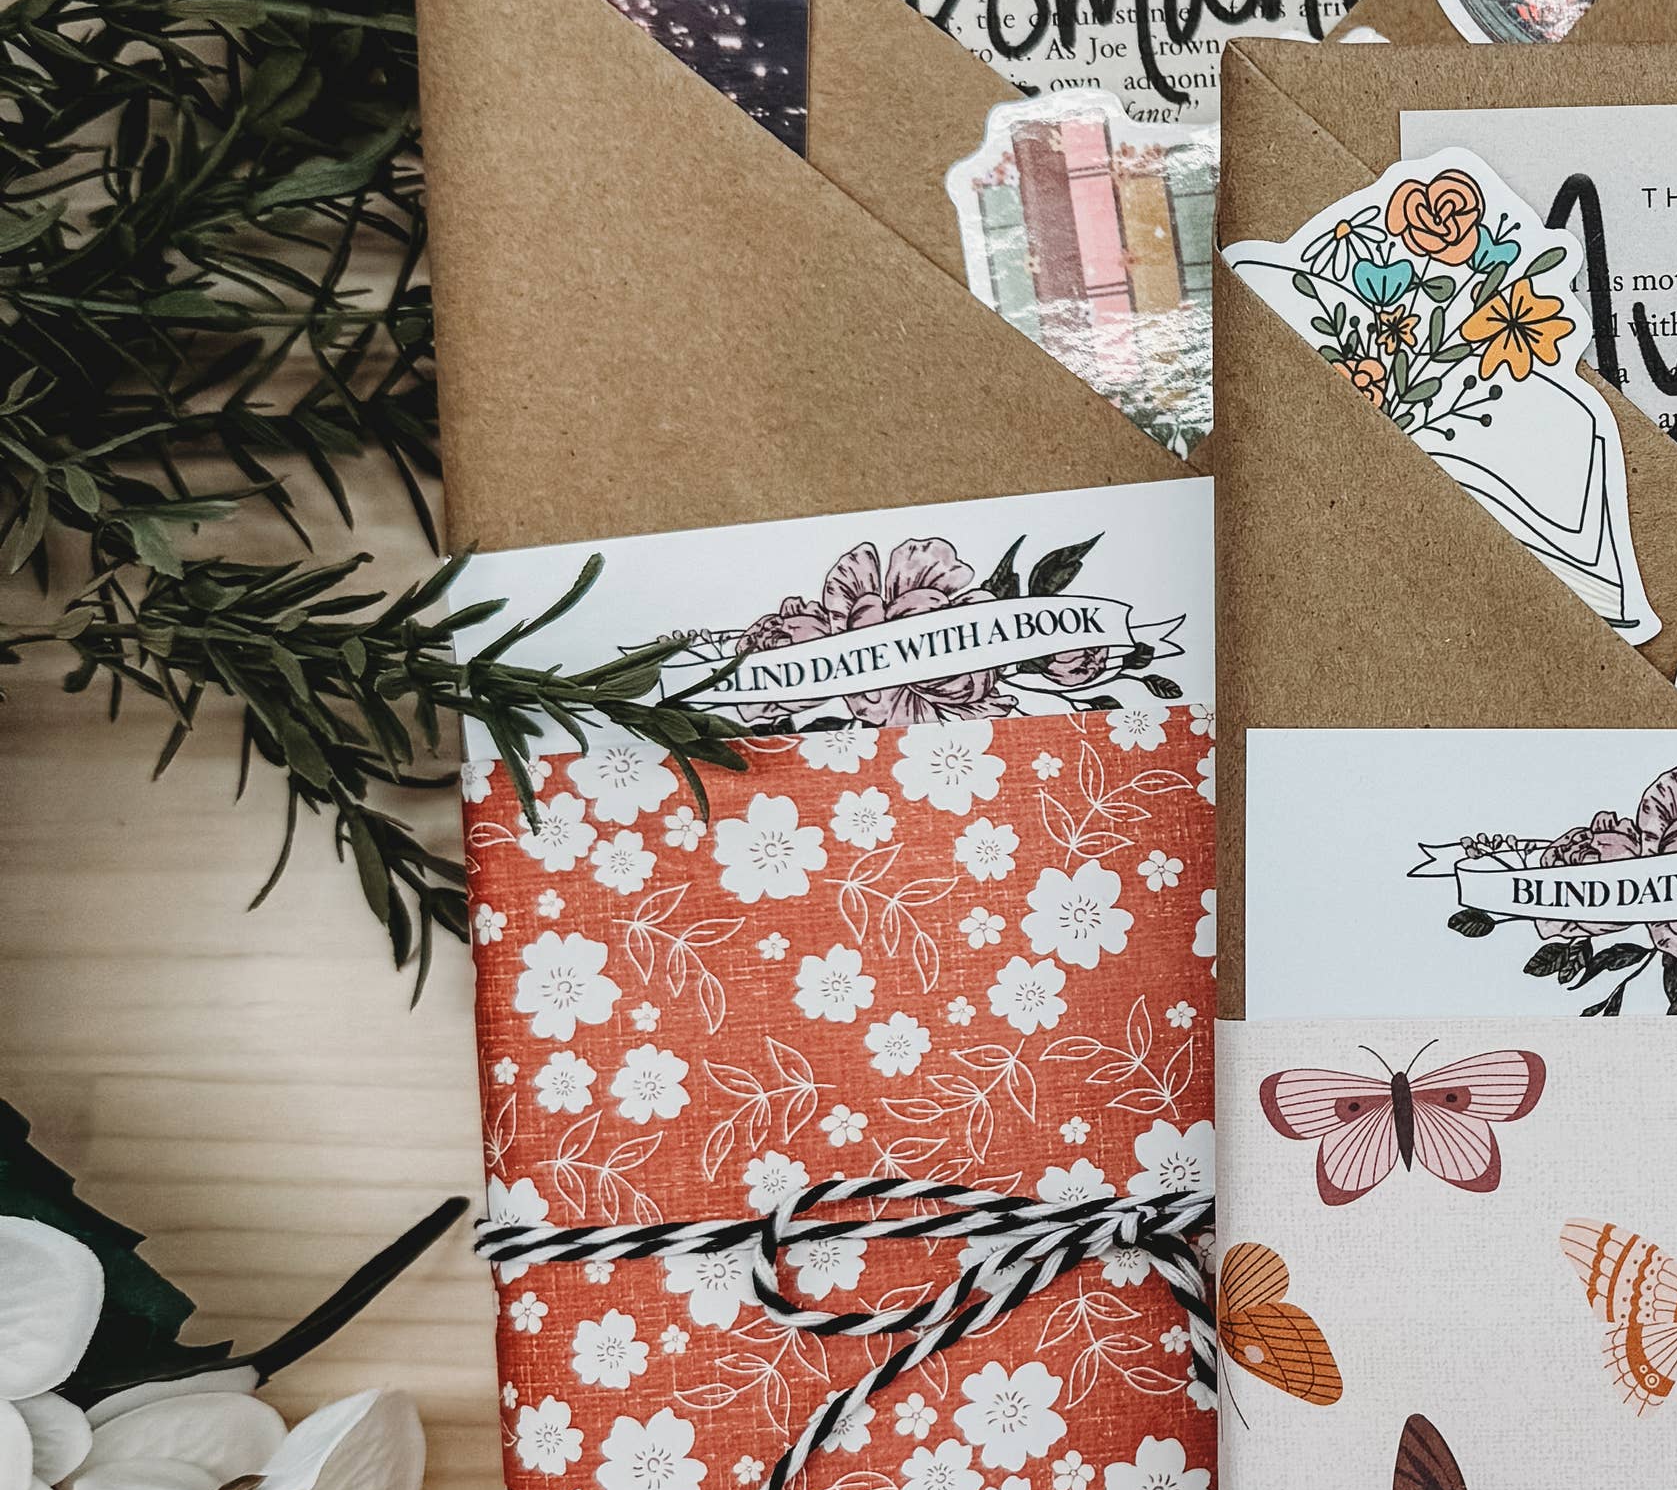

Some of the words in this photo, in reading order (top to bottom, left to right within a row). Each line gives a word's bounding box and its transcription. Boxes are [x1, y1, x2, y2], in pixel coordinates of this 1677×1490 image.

[1086, 37, 1128, 66] Joe
[811, 642, 890, 686] DATE
[895, 619, 982, 662] WITH
[986, 617, 1011, 644] A
[1015, 605, 1106, 640] BOOK
[1510, 876, 1610, 909] BLIND
